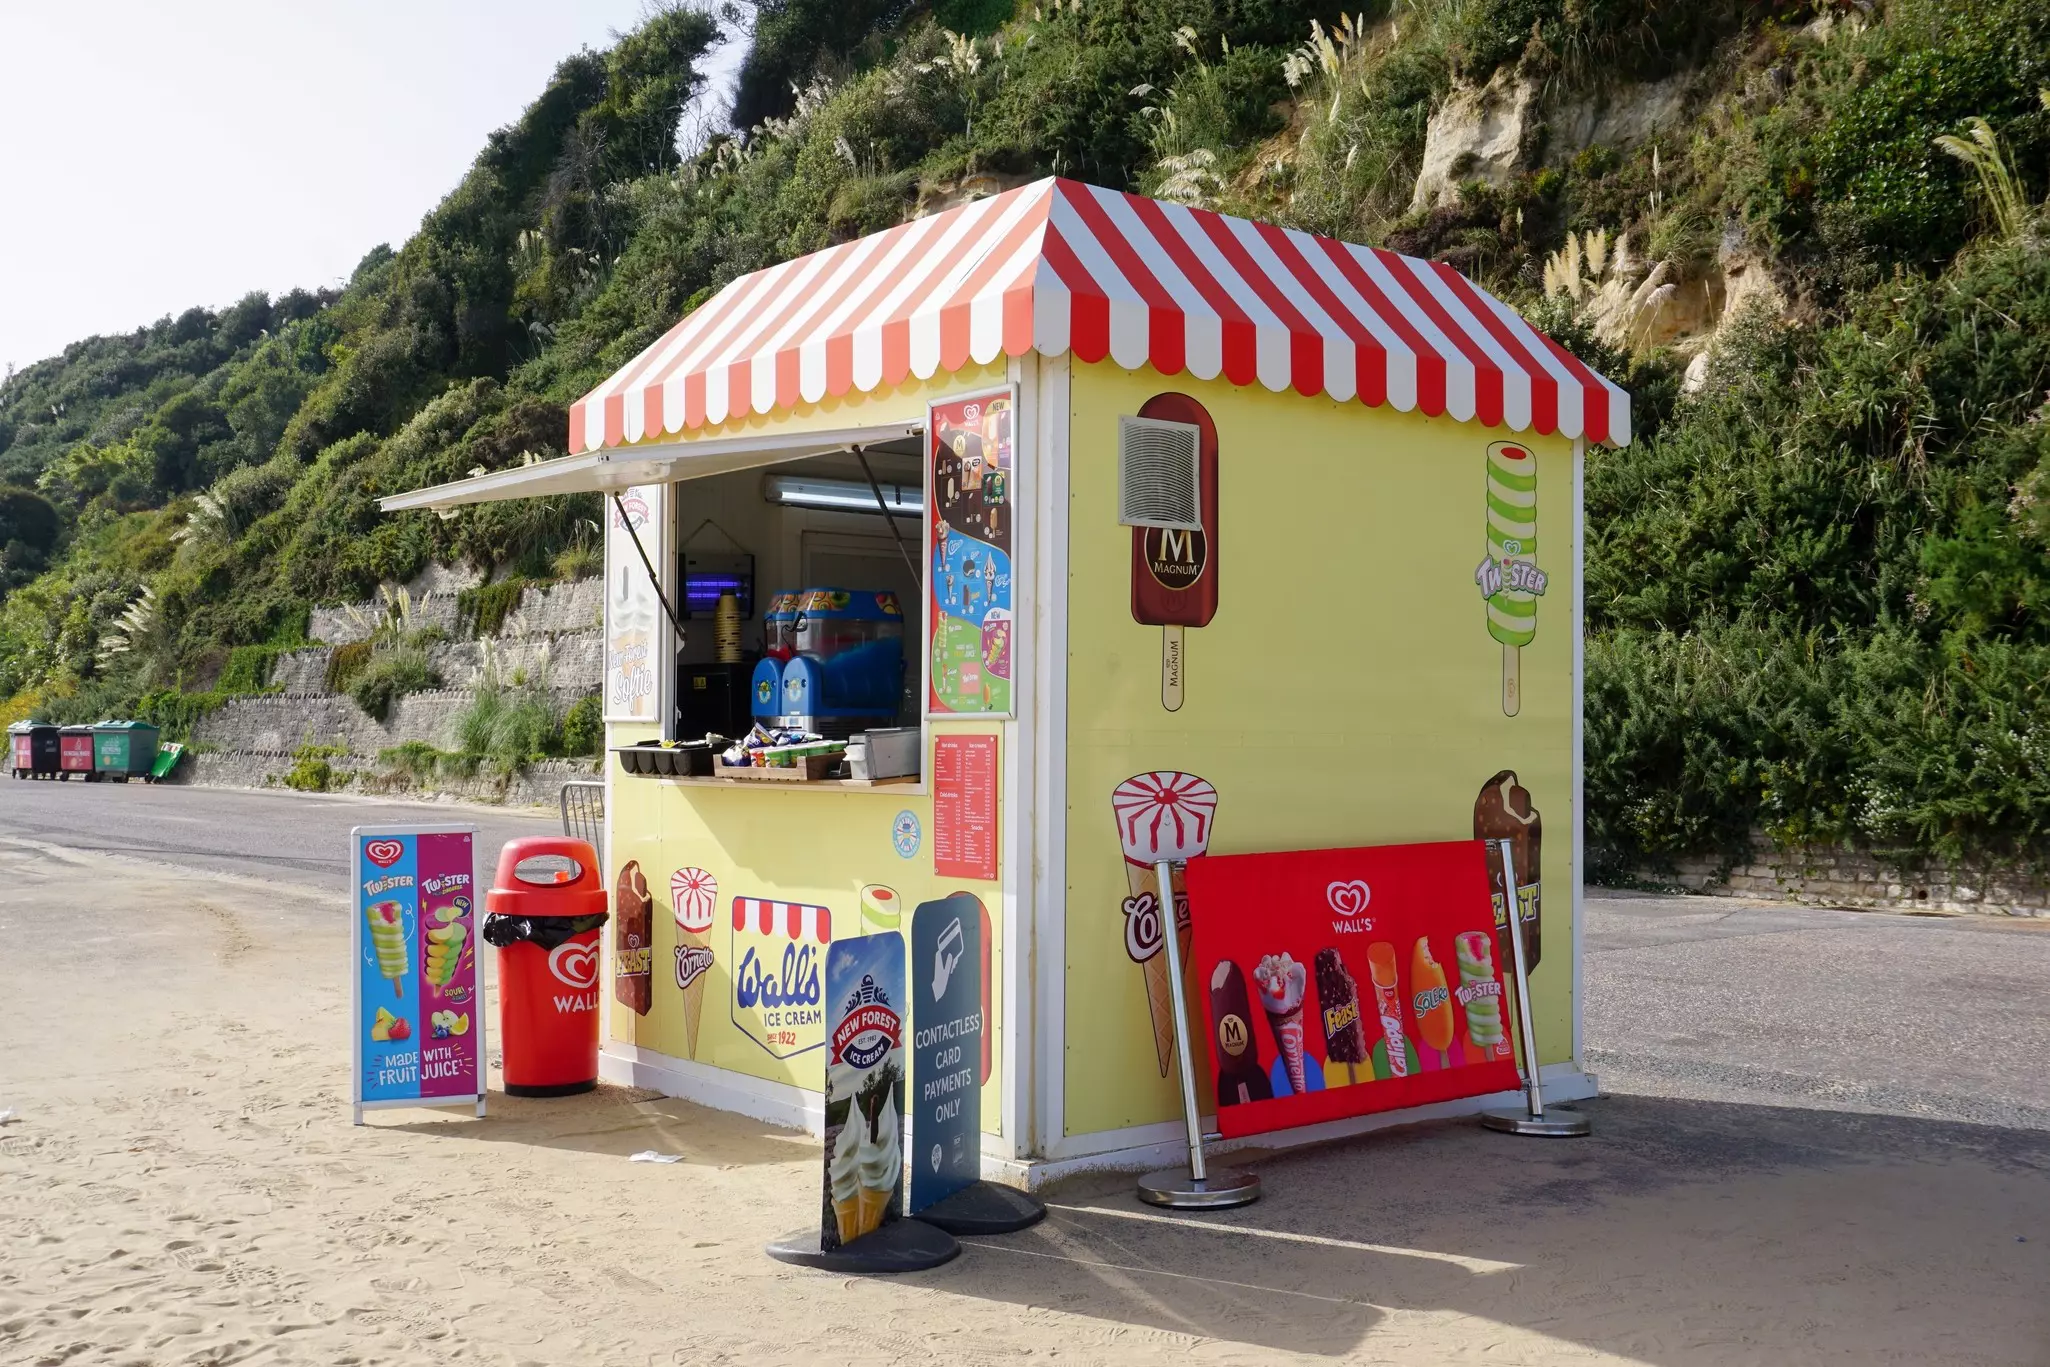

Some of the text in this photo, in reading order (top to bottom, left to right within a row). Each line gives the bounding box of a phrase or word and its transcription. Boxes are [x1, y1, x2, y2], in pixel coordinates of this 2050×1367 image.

[1158, 529, 1194, 563] M
[1154, 561, 1198, 576] MAGNUM
[1170, 640, 1179, 687] MAGNUM
[613, 663, 652, 711] Softie
[455, 898, 469, 909] NEW
[1332, 918, 1373, 934] WALL'S
[674, 944, 715, 989] Cornetto
[737, 941, 820, 1009] Wall's
[764, 1010, 822, 1027] ICE CREAM
[837, 1011, 897, 1047] NEW FOREST
[915, 1013, 980, 1049] CONTACTLESS
[778, 1030, 796, 1045] 1922
[423, 1046, 452, 1062] WITH
[850, 1043, 884, 1065] ICE CREAM
[935, 1046, 961, 1070] CARD
[924, 1068, 972, 1101] PAYMENTS
[935, 1098, 961, 1123] ONLY
